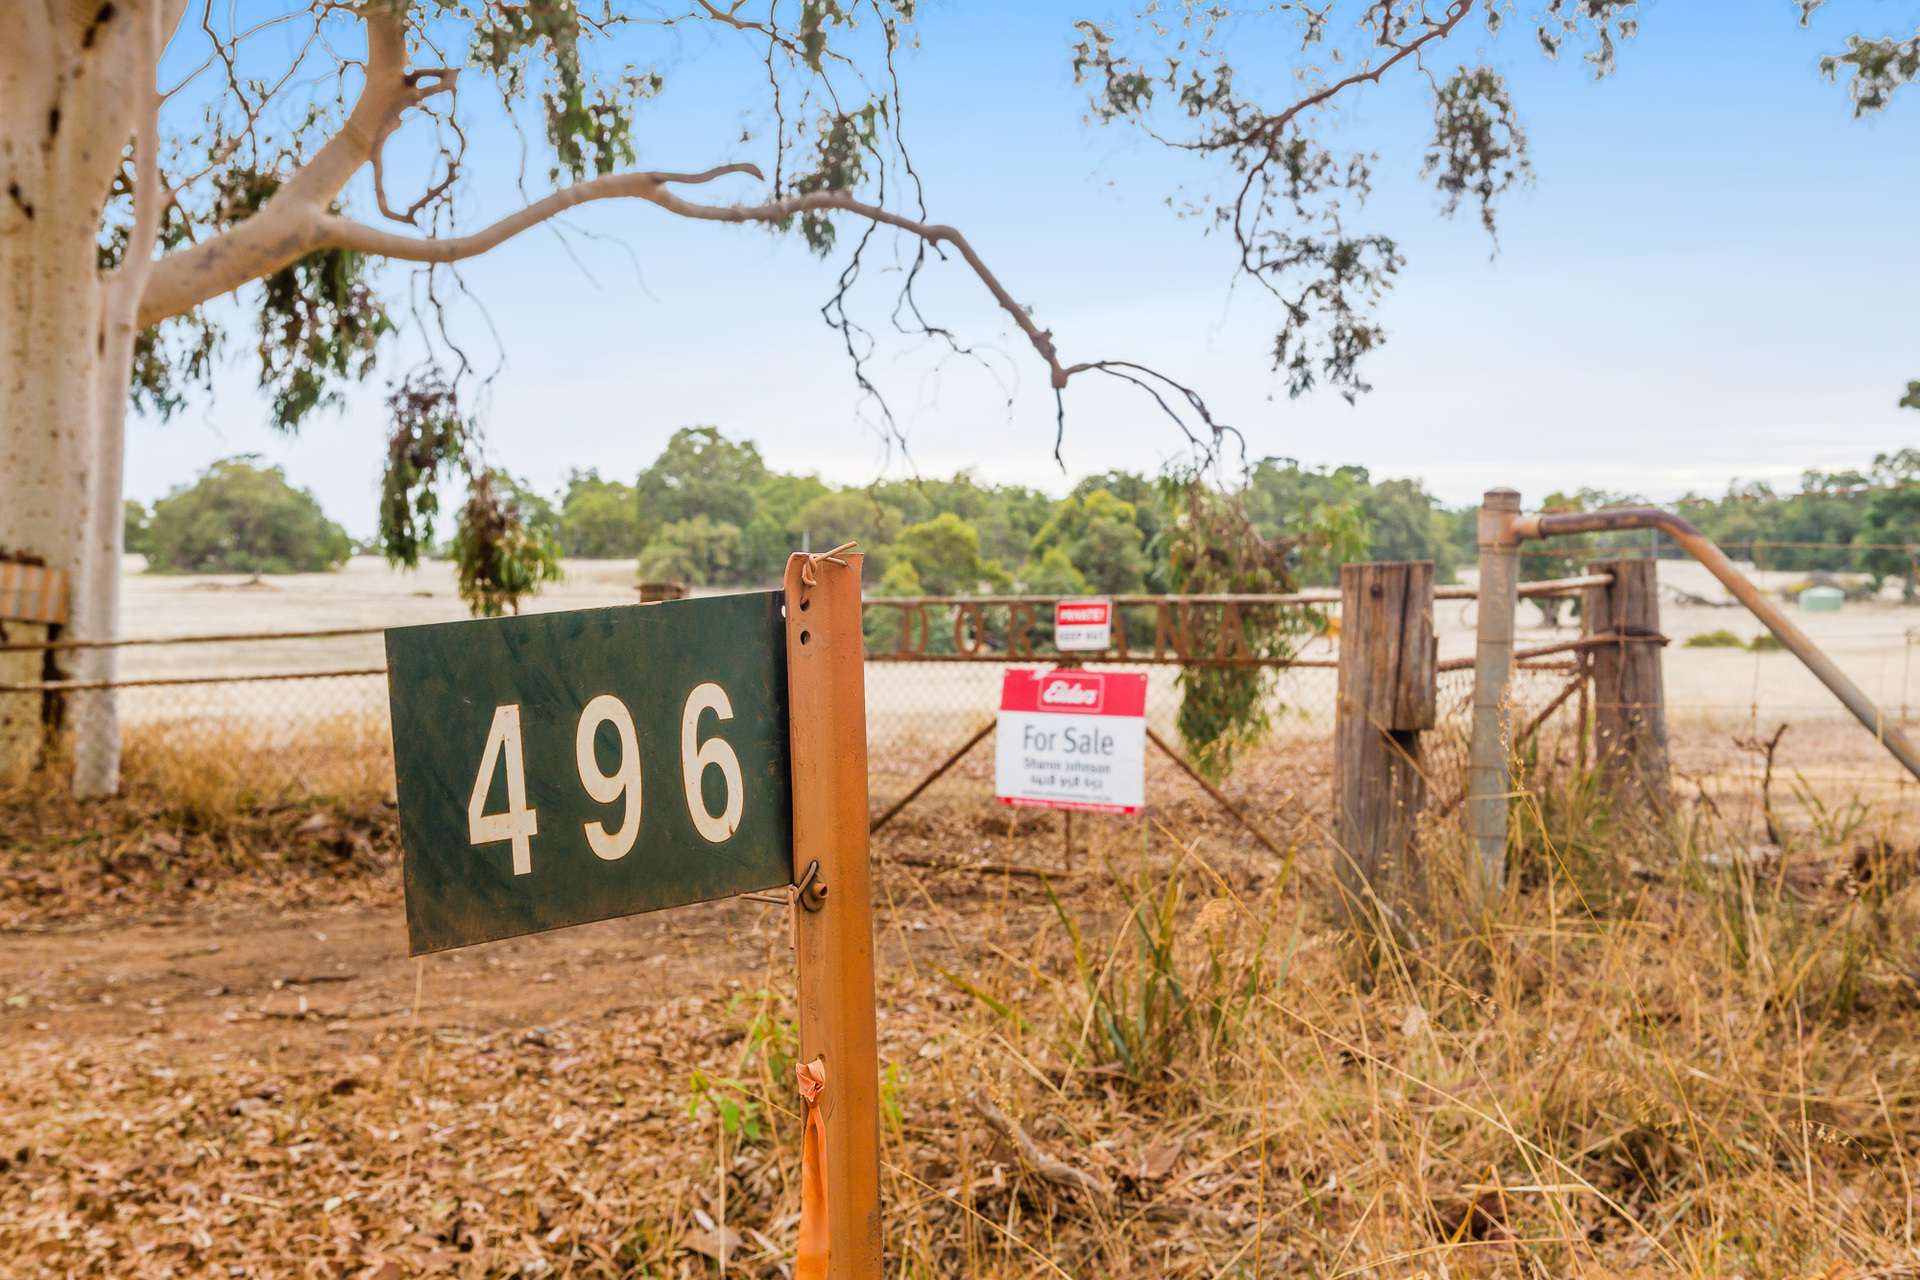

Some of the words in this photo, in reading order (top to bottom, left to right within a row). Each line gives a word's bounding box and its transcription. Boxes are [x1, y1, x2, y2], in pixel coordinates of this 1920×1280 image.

[897, 598, 1250, 660] DORANA
[1023, 725, 1057, 752] For
[1063, 726, 1114, 756] Sale
[468, 681, 744, 876] 496
